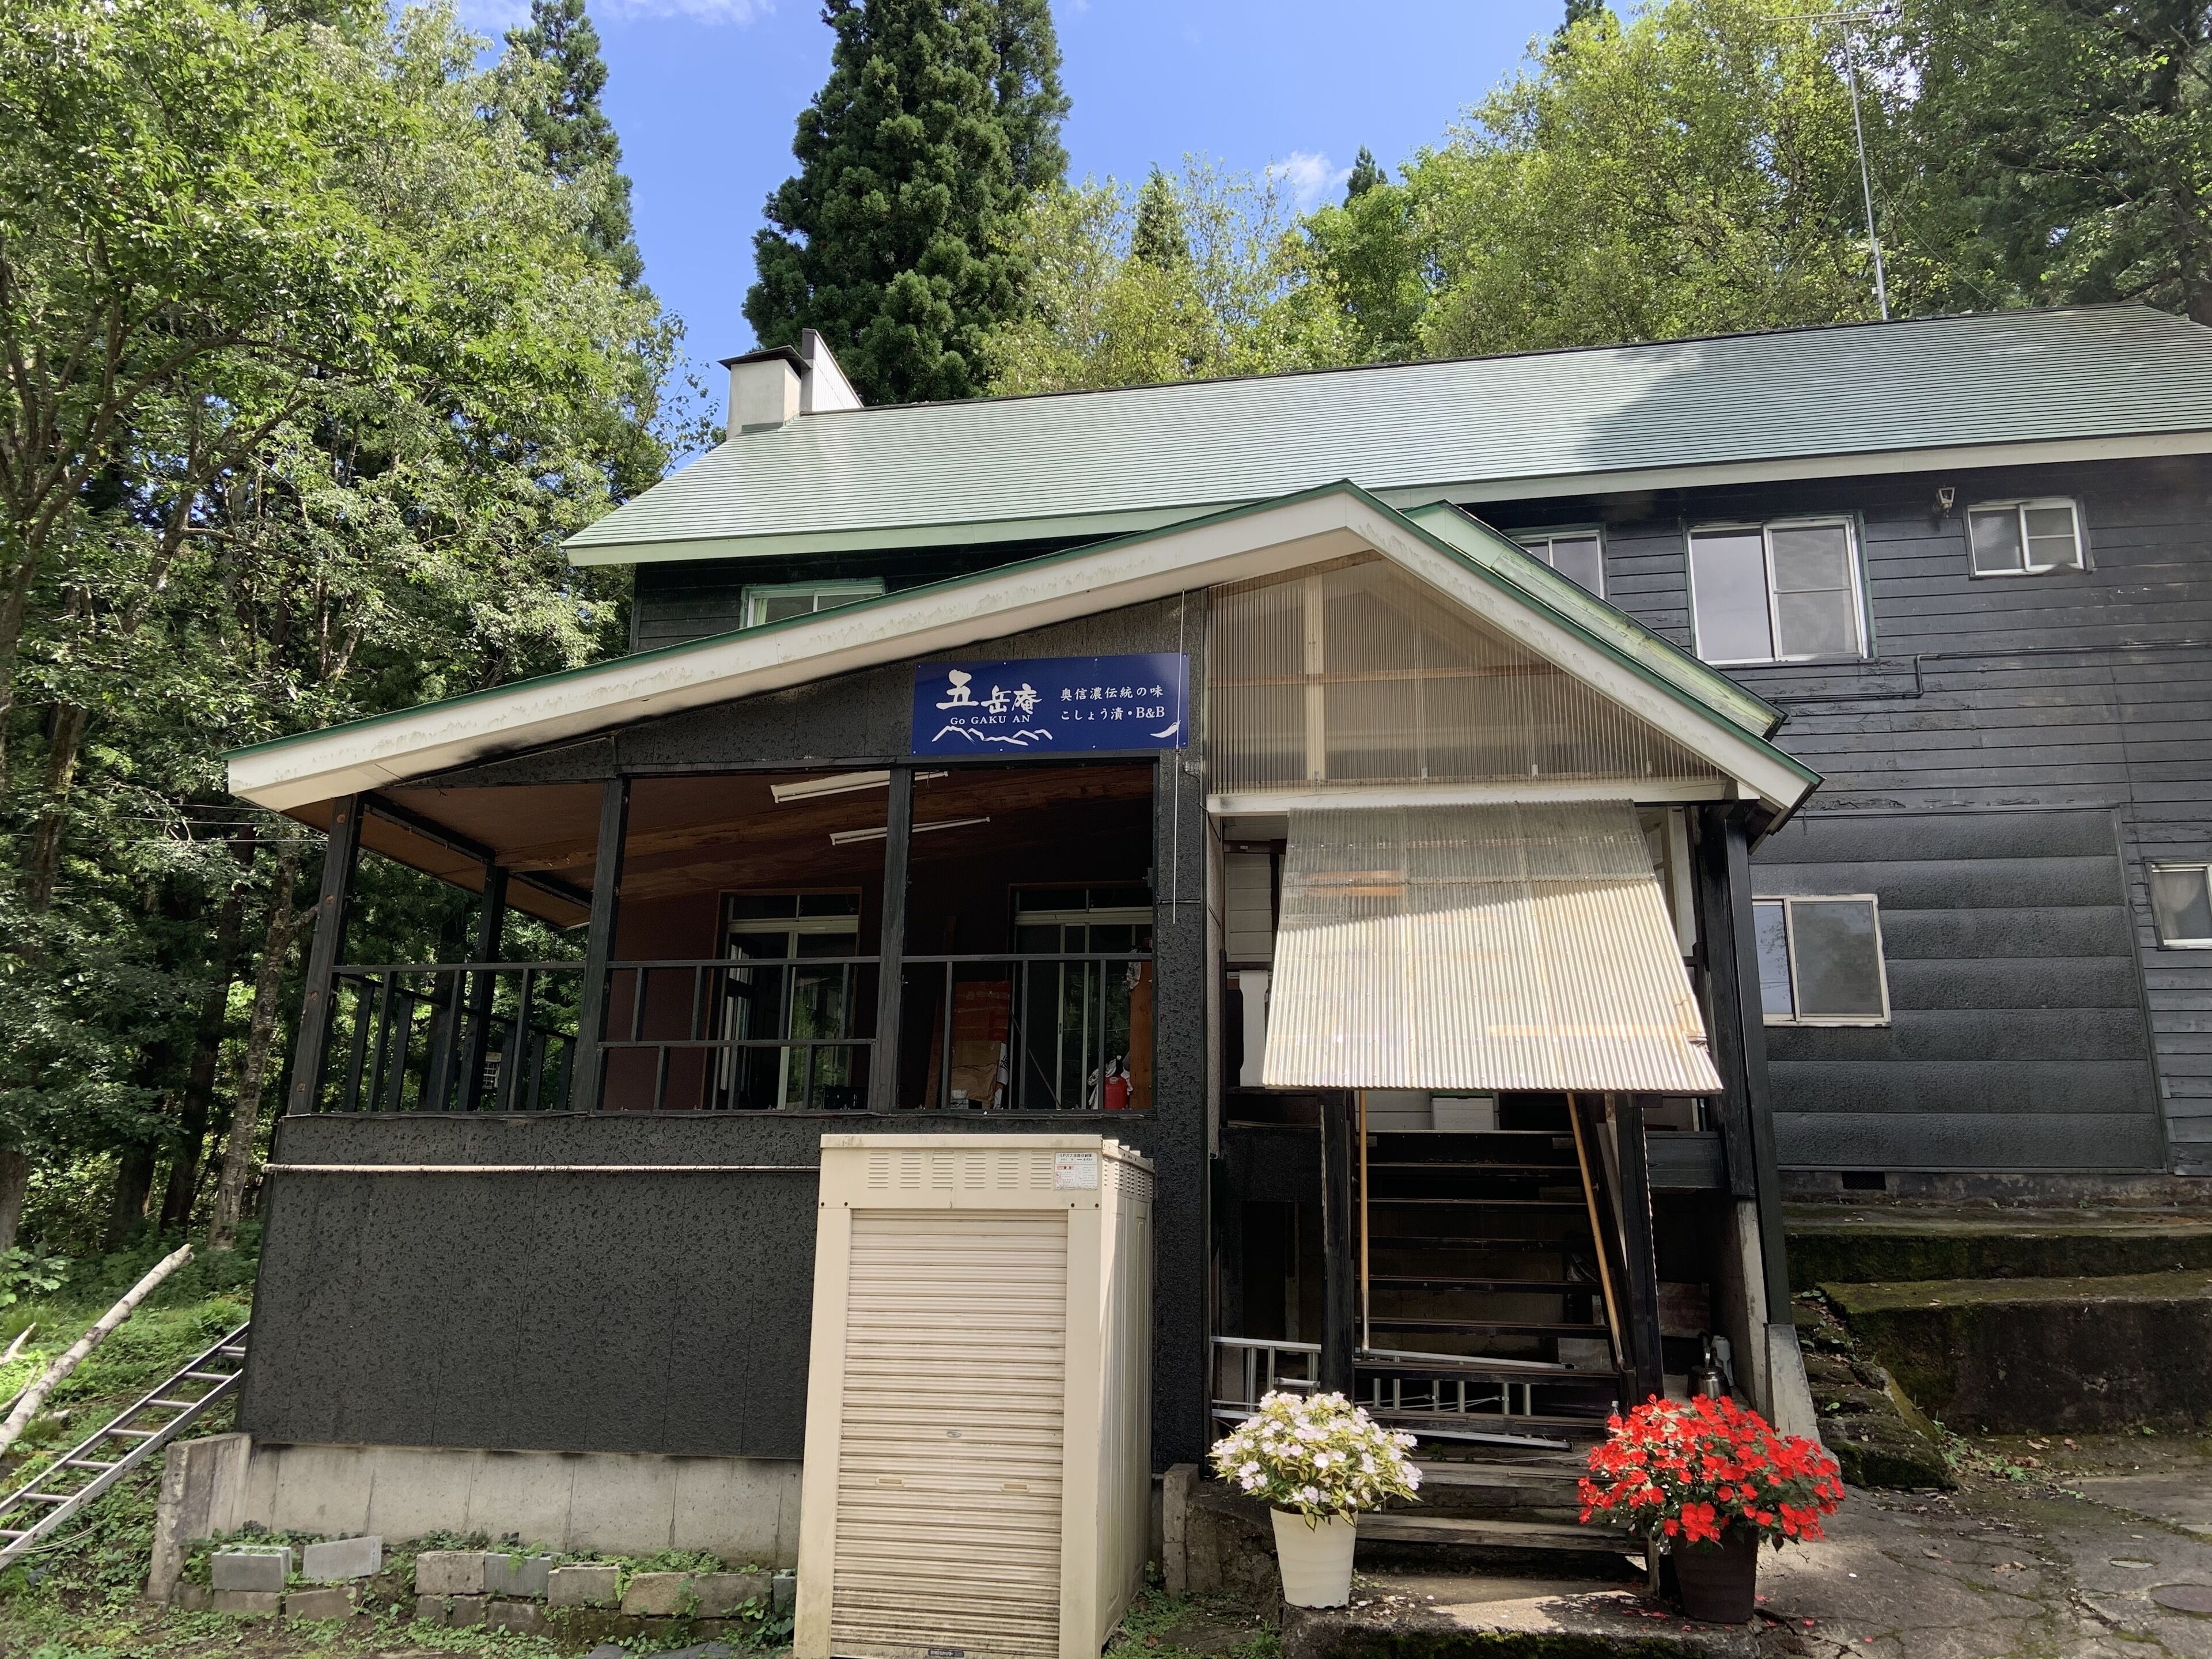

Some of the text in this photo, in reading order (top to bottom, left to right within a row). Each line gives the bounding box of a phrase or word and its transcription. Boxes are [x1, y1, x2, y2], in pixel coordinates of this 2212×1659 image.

[936, 669, 1043, 714] 五岳庵
[1060, 685, 1164, 701] 奥信濃伝統の味
[971, 715, 1006, 724] GAKU
[1012, 715, 1031, 723] AN
